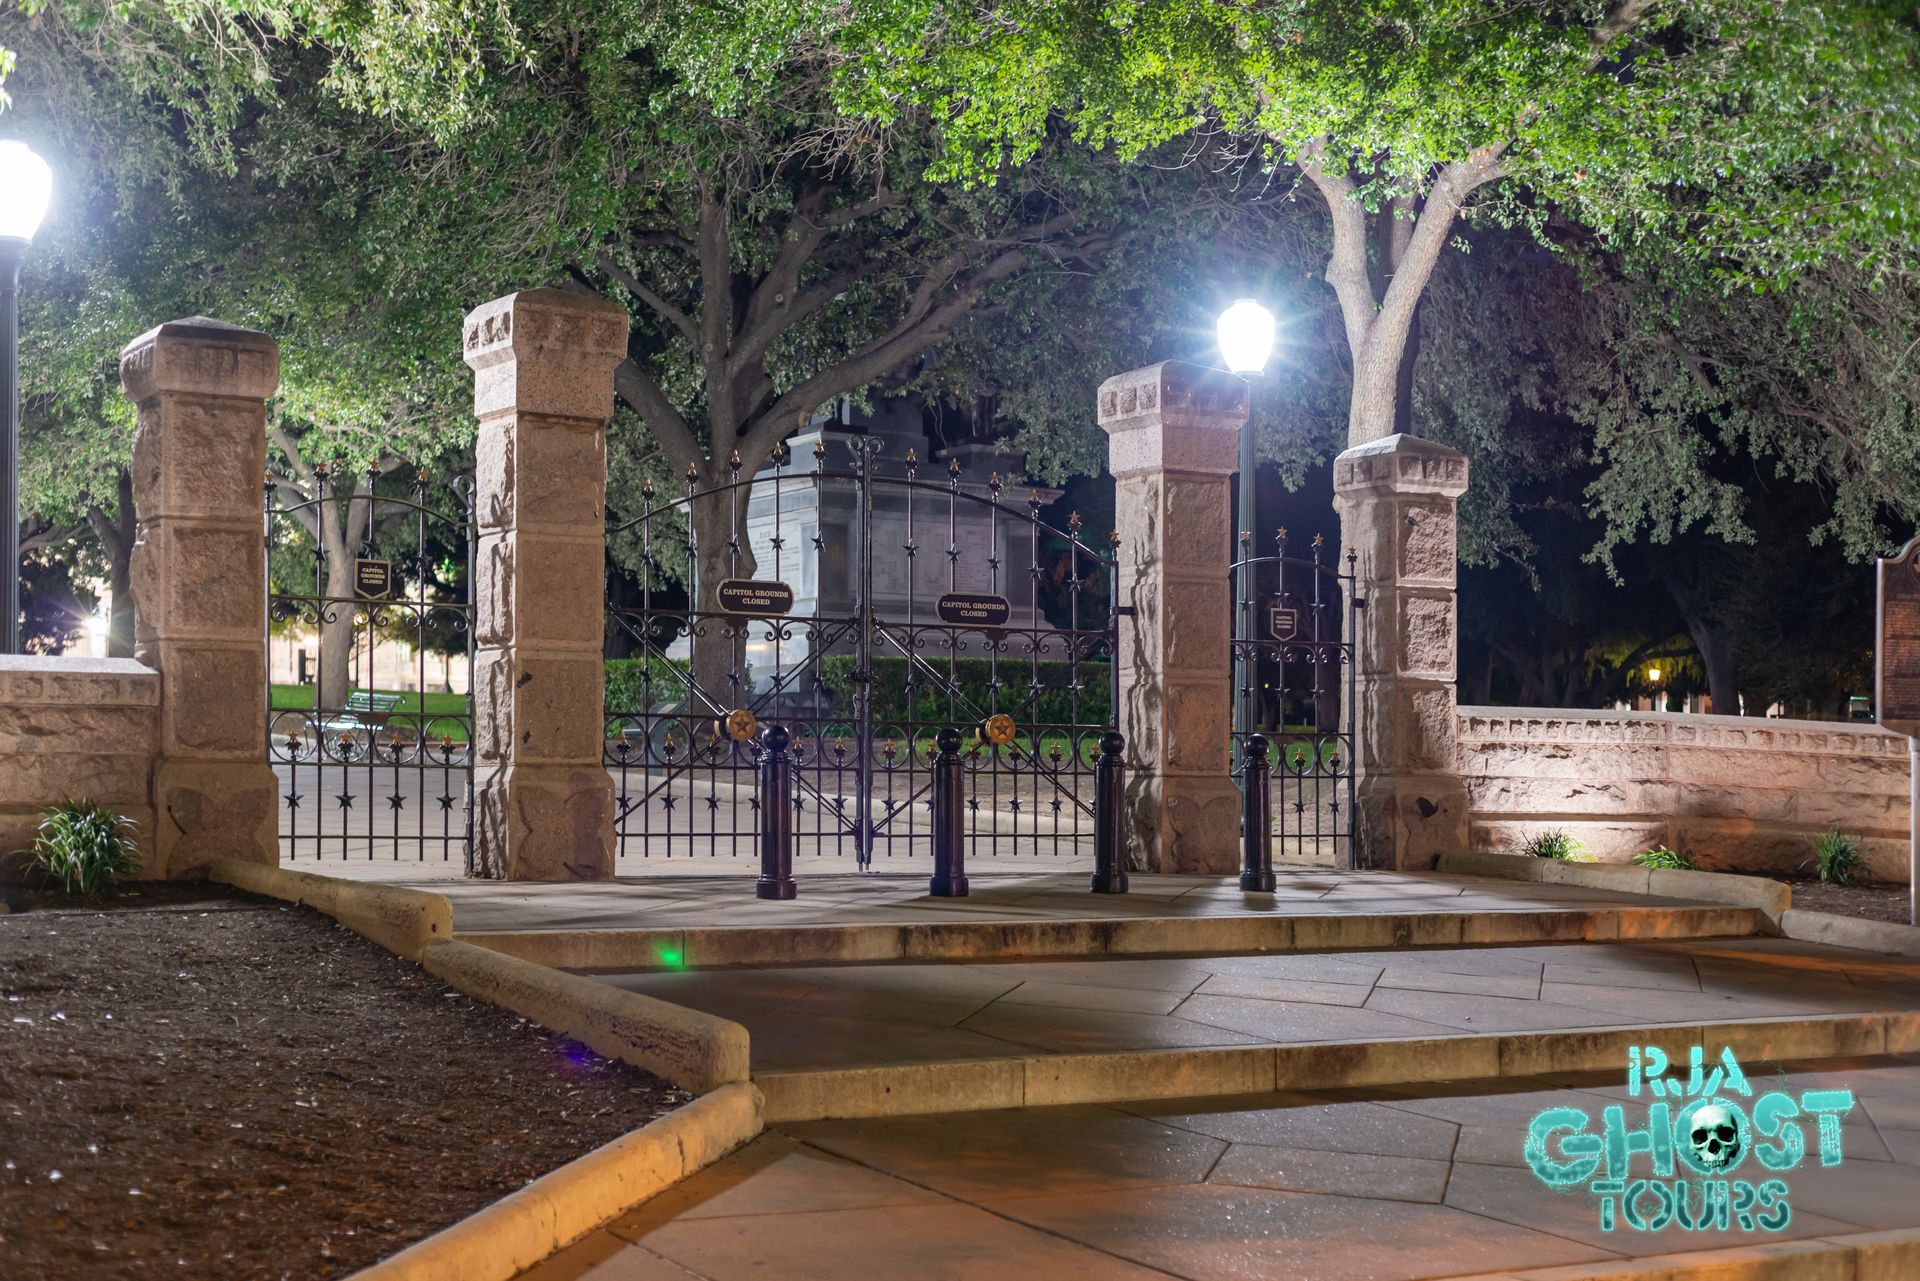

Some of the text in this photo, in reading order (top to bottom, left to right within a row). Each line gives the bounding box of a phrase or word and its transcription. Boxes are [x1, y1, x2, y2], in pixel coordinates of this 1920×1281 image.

[723, 588, 789, 598] CAPITOL GROUNDS
[942, 601, 1006, 611] CAPITOL GROUNDS
[960, 610, 988, 618] CLOSED
